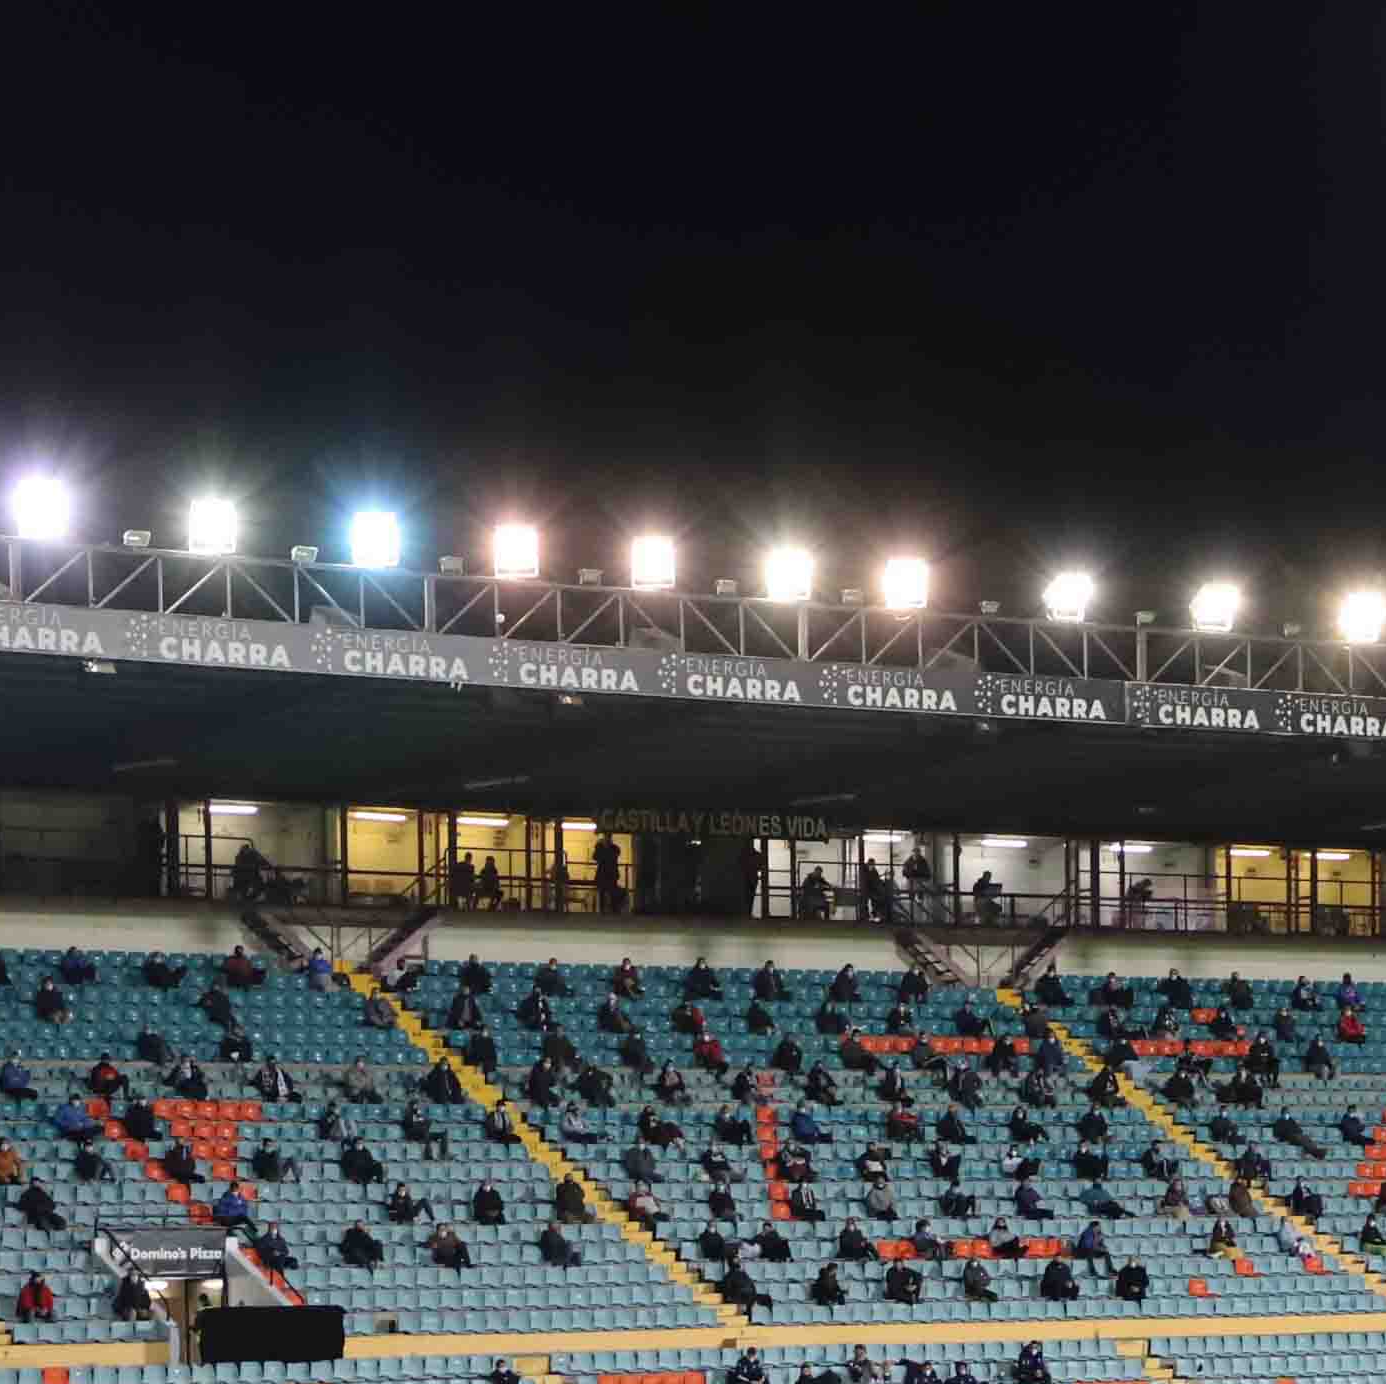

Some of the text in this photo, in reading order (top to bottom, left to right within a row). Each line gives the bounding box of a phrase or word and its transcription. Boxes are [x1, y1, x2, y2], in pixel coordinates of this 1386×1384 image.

[160, 636, 292, 668] CHARRA
[520, 647, 604, 666] ENERGÍA
[345, 651, 469, 680] CHARRA
[687, 658, 766, 677] ENERGÍA
[520, 664, 639, 691] CHARRA
[687, 675, 801, 701] CHARRA
[847, 668, 924, 687] ENERGÍA
[1001, 679, 1075, 697] ENERGÍA
[848, 685, 957, 711] CHARRA
[1001, 696, 1106, 719] CHARRA
[1159, 689, 1229, 707] ENERGÍA
[1300, 698, 1369, 715] ENERGÍA
[1159, 705, 1260, 729] CHARRA
[787, 815, 827, 839] VIDA
[131, 1248, 223, 1260] Domino's Pizza
